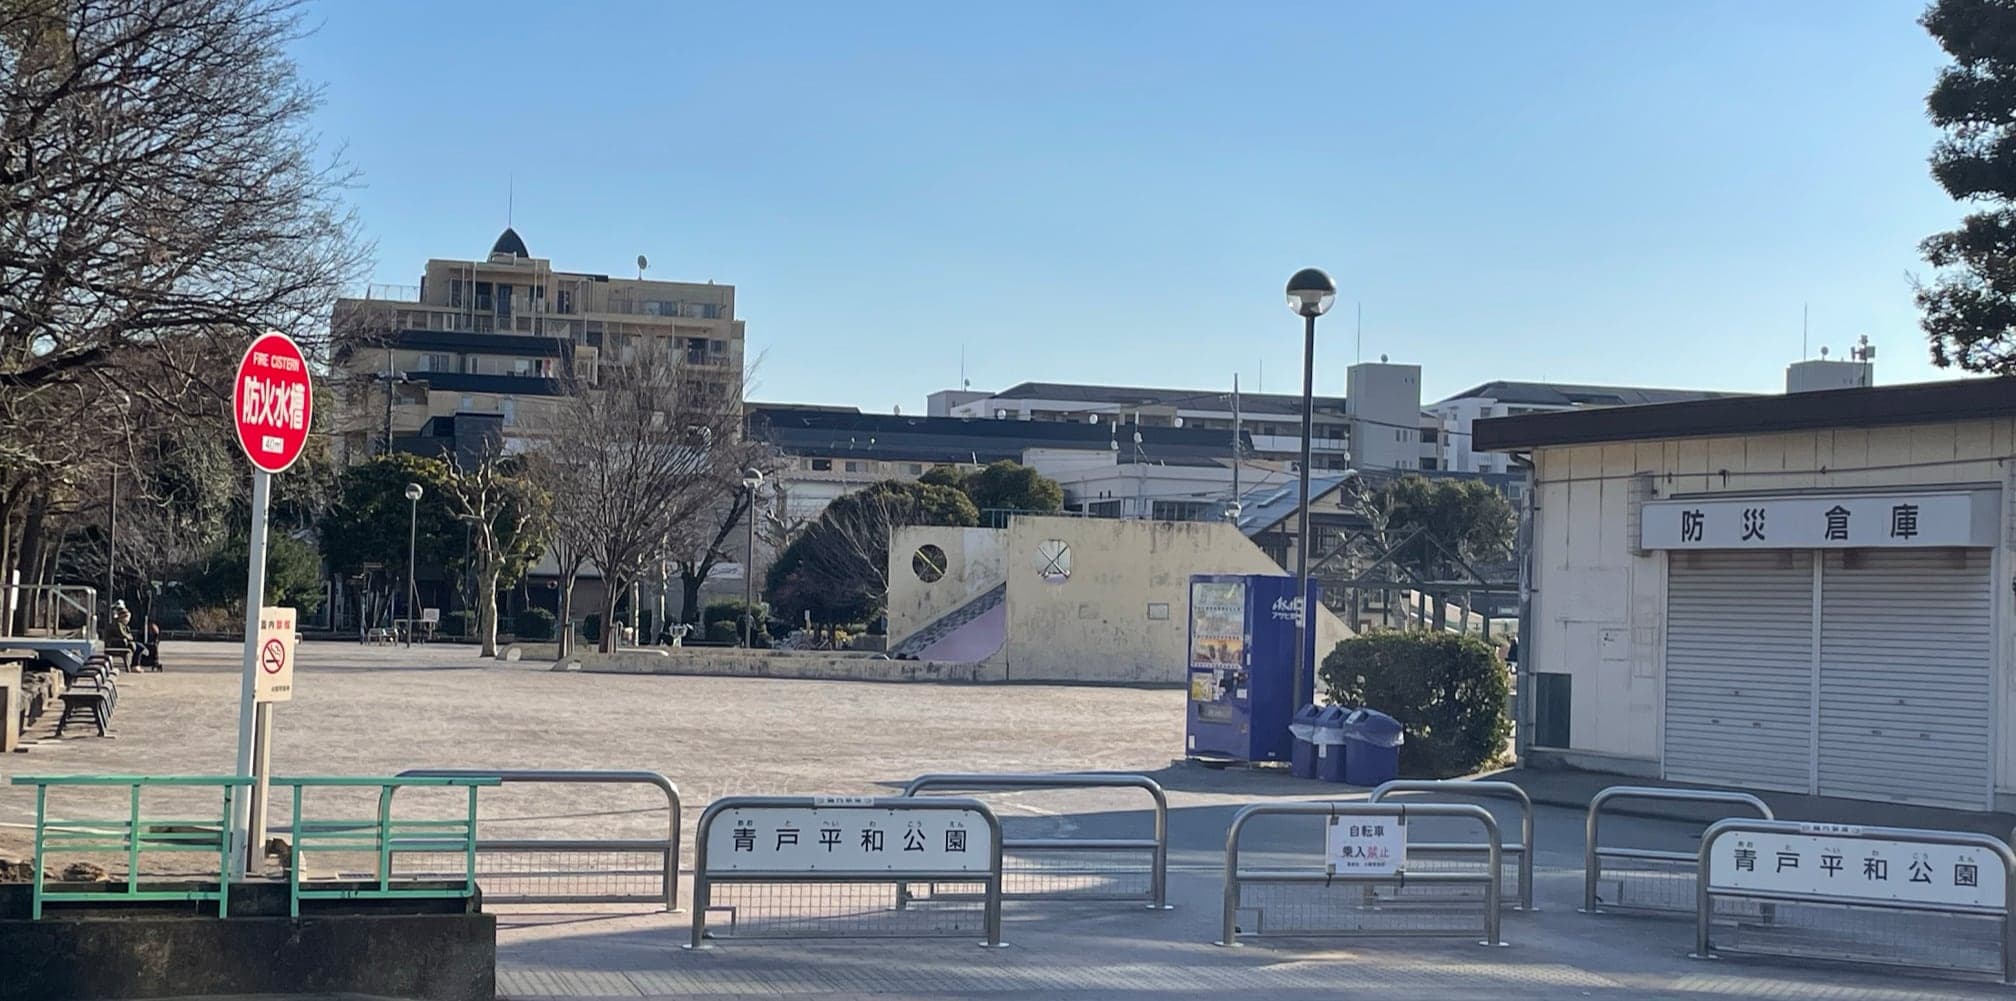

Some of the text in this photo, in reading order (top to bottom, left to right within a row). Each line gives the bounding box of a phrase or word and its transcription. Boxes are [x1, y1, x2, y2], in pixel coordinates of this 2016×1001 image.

[253, 351, 300, 373] FIRE CISTERN
[242, 375, 306, 430] 防火水槽
[733, 827, 966, 852] 青戸平和公園
[1350, 825, 1384, 837] 自転車
[1341, 846, 1390, 859] 乗入禁止
[1734, 849, 1978, 887] 青戸平和公園
